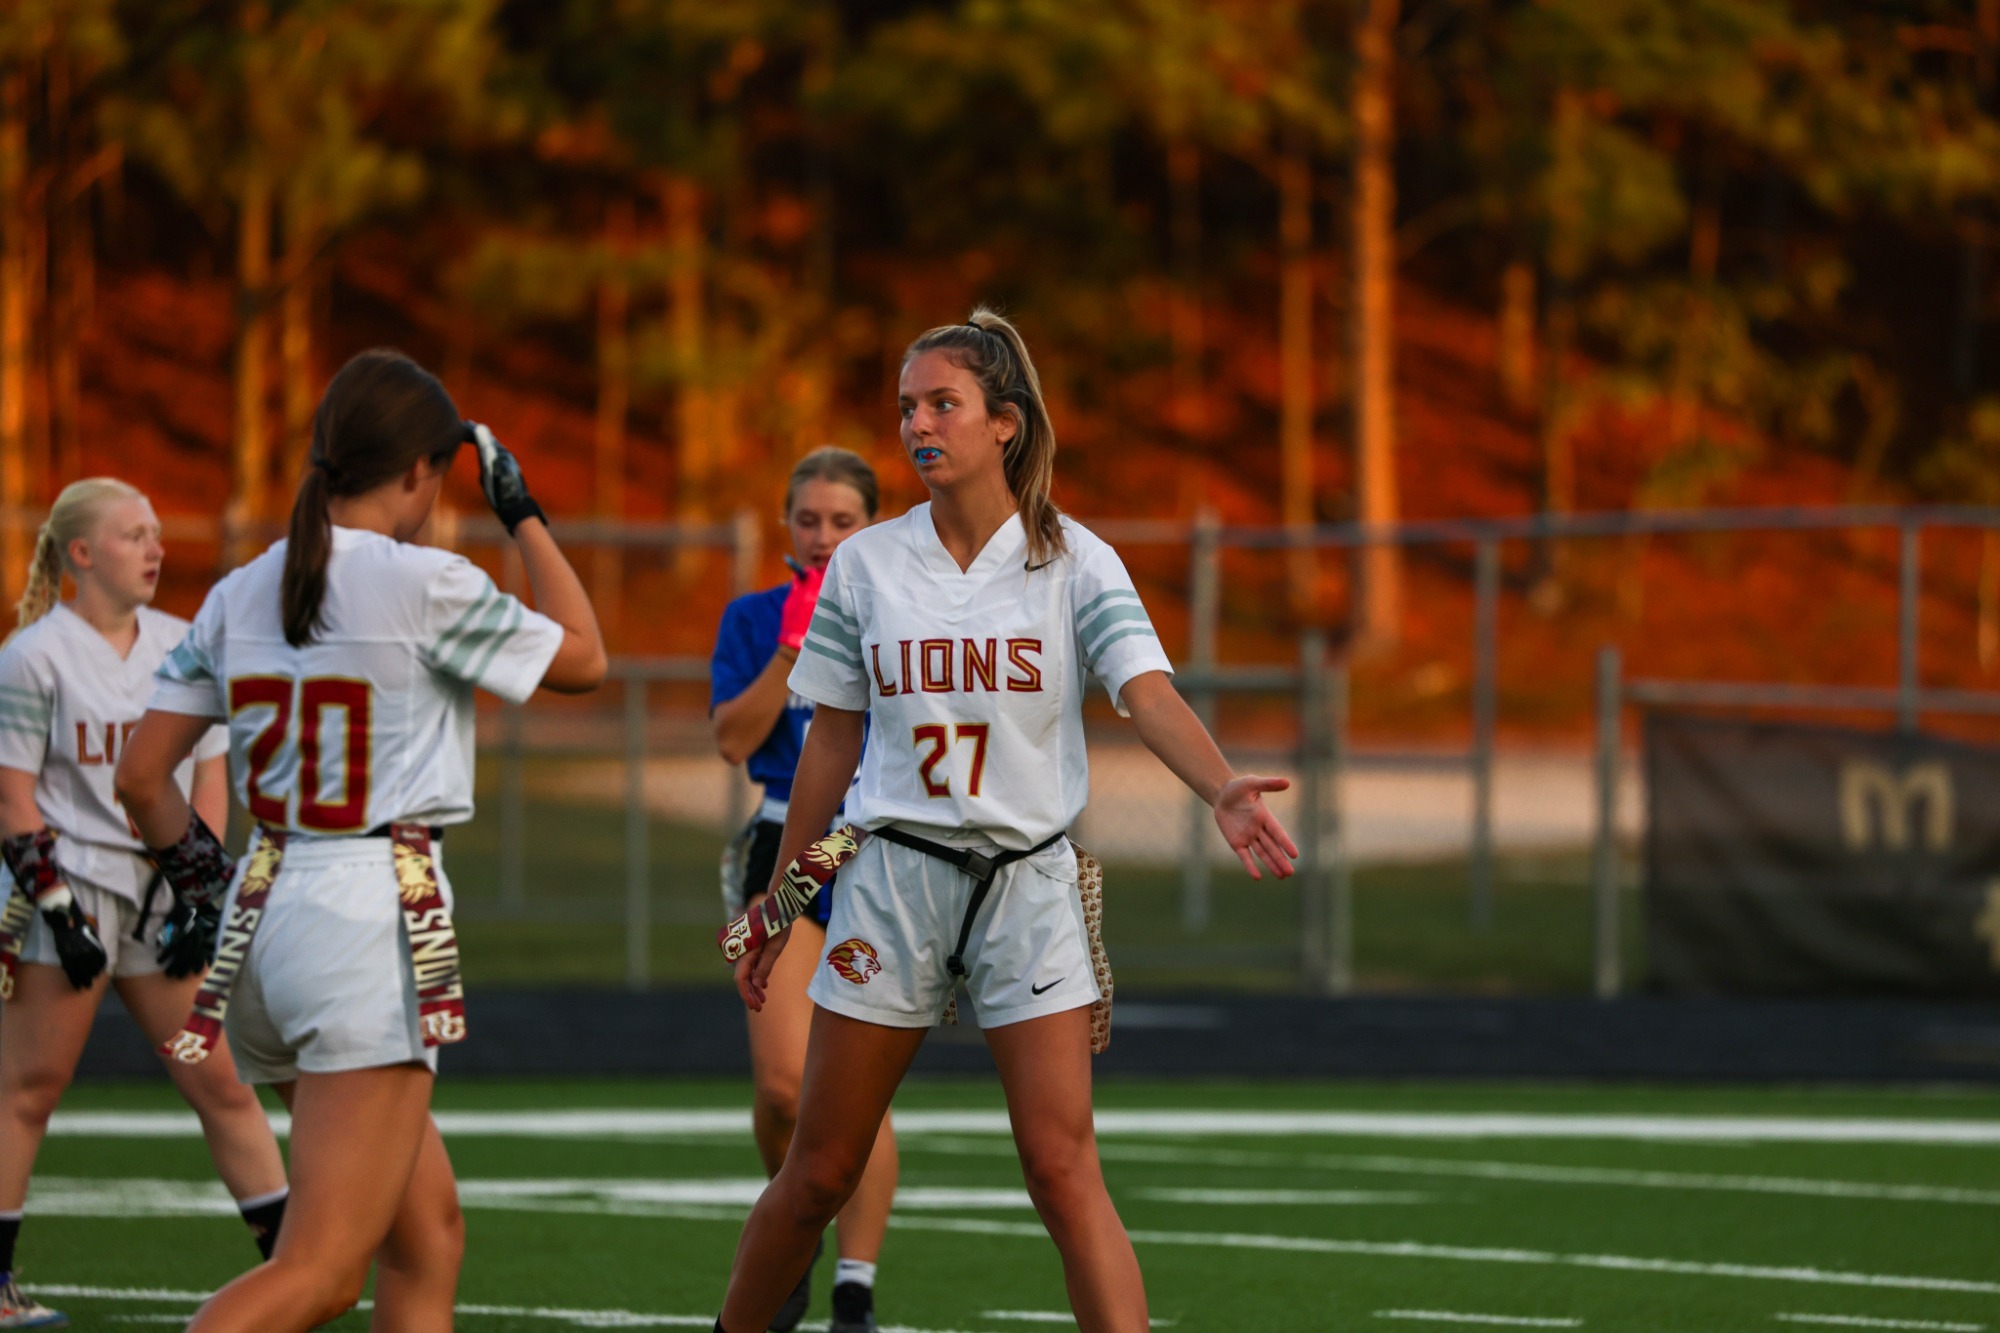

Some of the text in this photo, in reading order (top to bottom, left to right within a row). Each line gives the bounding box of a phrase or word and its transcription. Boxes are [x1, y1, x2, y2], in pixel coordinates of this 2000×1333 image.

[870, 638, 1044, 697] LIONS
[228, 674, 373, 834] 20
[912, 722, 990, 799] 27
[759, 859, 822, 939] LIONS
[192, 904, 263, 1021] LIONS
[402, 906, 464, 1004] LIONS
